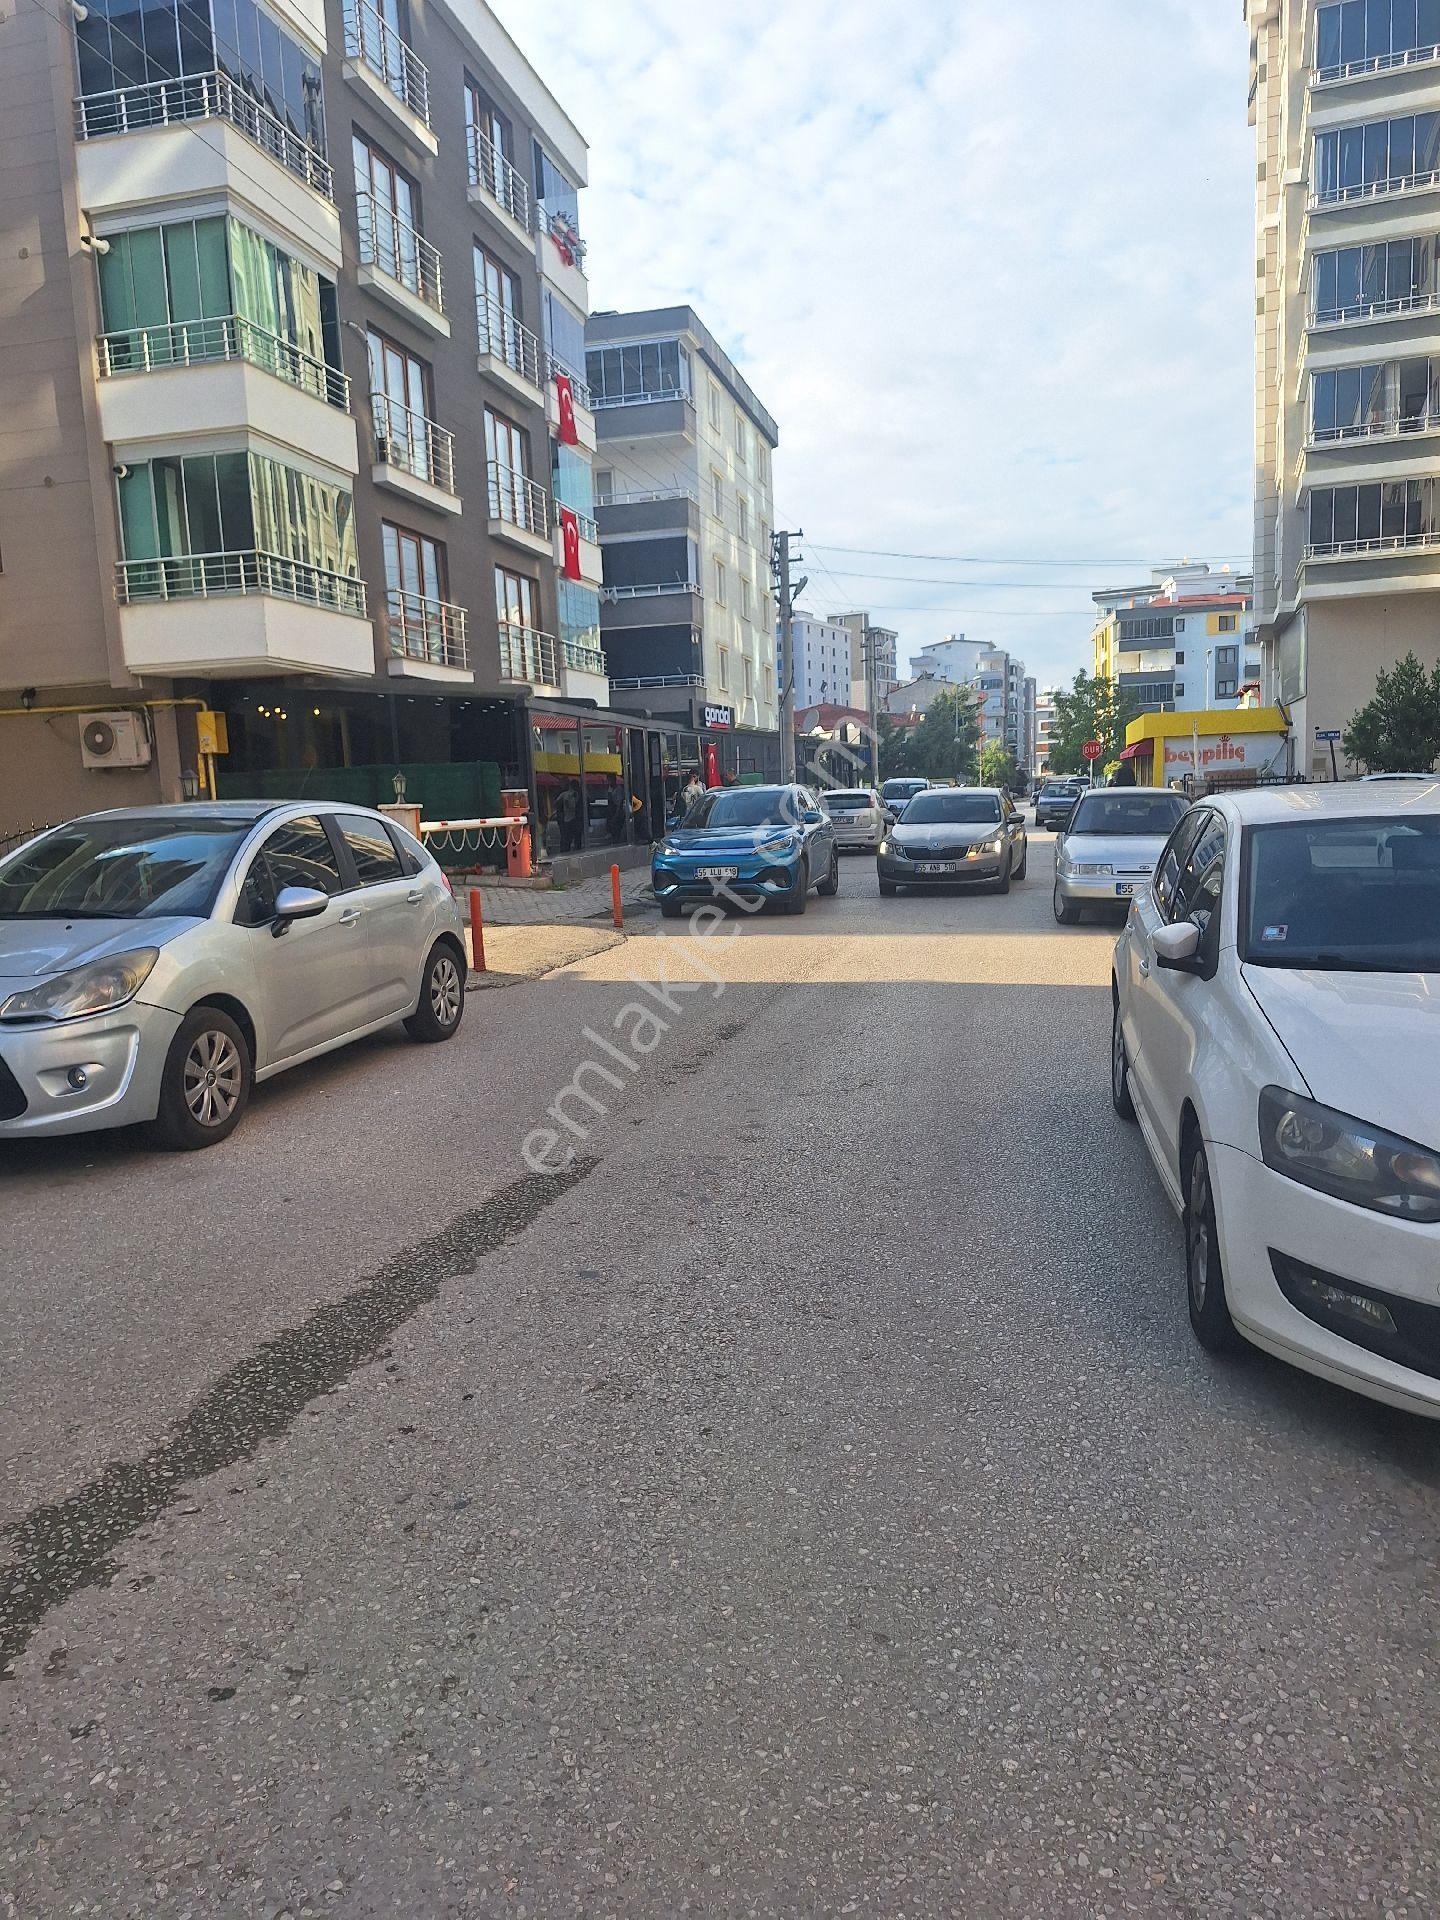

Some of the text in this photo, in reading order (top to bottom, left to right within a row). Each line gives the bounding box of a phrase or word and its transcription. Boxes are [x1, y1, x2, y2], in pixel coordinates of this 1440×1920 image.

[1084, 745, 1100, 754] DUR
[1164, 742, 1245, 766] beypiliç
[698, 868, 707, 877] 55
[1121, 884, 1133, 893] 55
